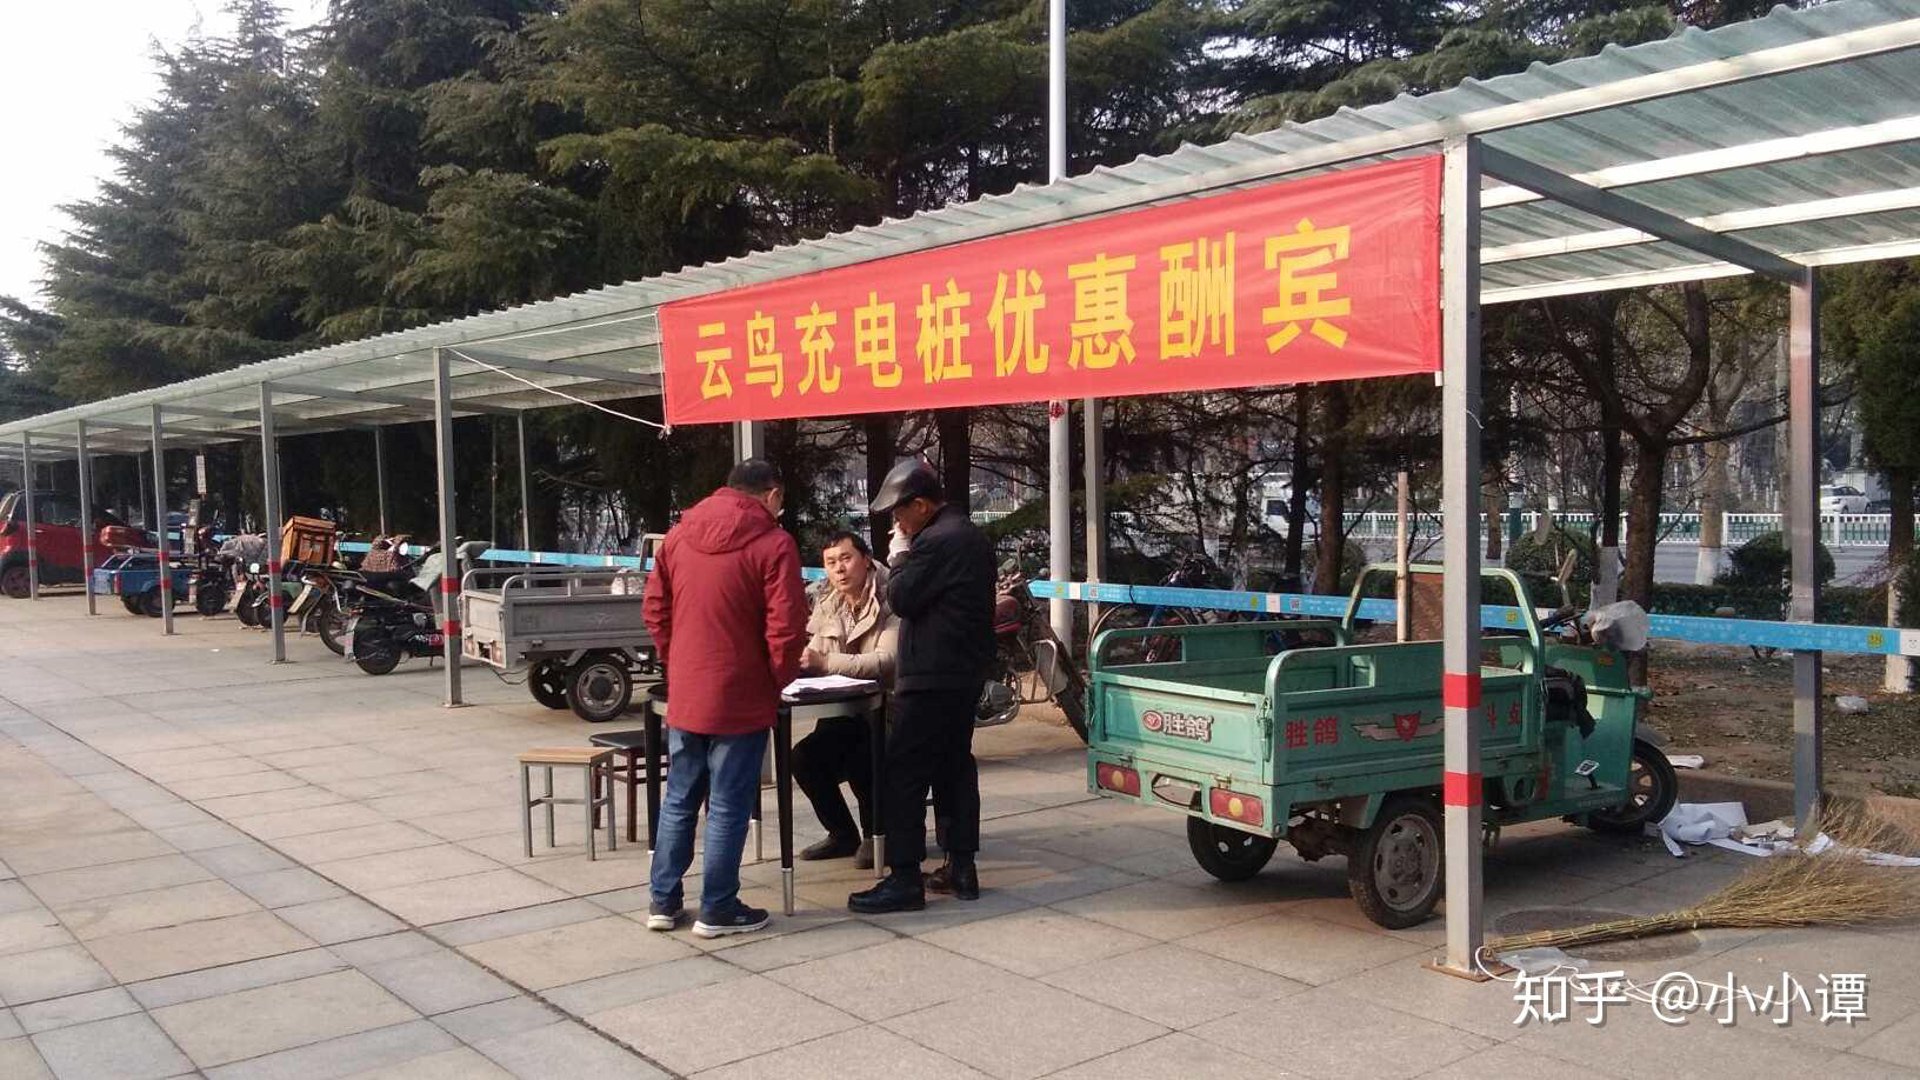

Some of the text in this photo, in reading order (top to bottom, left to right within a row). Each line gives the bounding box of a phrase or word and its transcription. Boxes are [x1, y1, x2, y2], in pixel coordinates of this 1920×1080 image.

[694, 218, 1354, 400] 云鸟充电桩优惠酬宾
[1163, 712, 1211, 742] 胜鸽
[1284, 716, 1338, 748] 胜鸽
